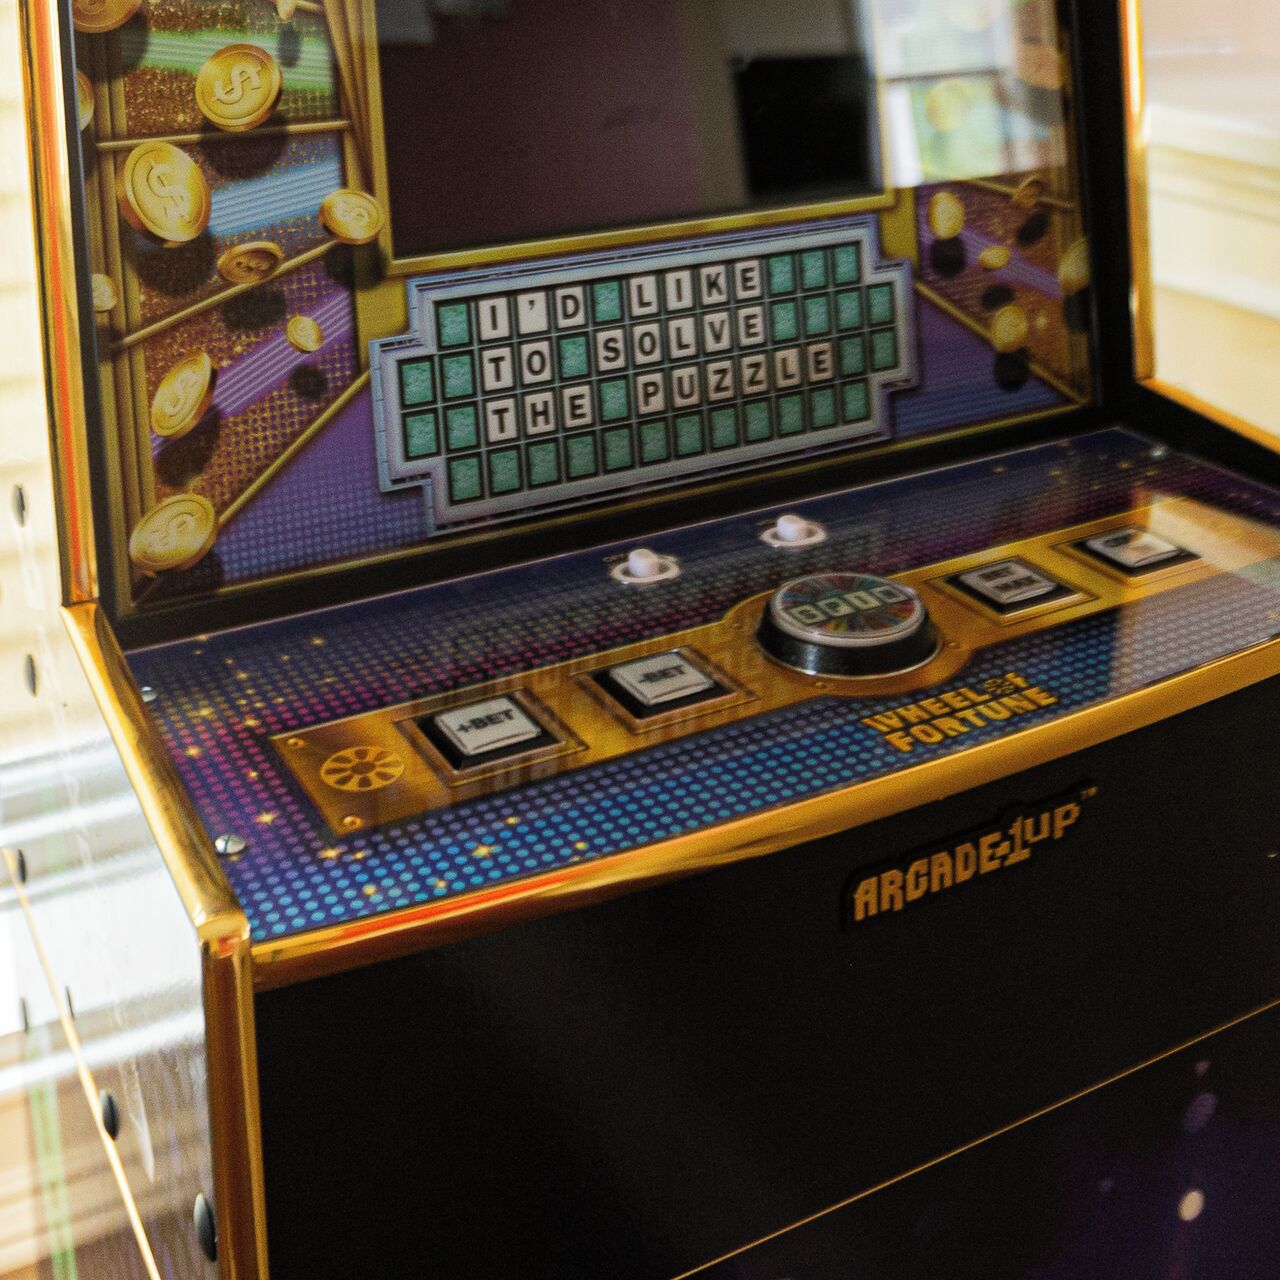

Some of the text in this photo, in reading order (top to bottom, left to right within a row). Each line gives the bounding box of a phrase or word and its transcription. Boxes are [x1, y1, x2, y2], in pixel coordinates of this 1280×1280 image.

[635, 265, 760, 310] LIKE
[488, 311, 763, 385] TO SOLVE
[490, 349, 831, 436] THE PUZZLE
[861, 686, 993, 733] WHEEL
[883, 686, 1060, 752] FORTUNE
